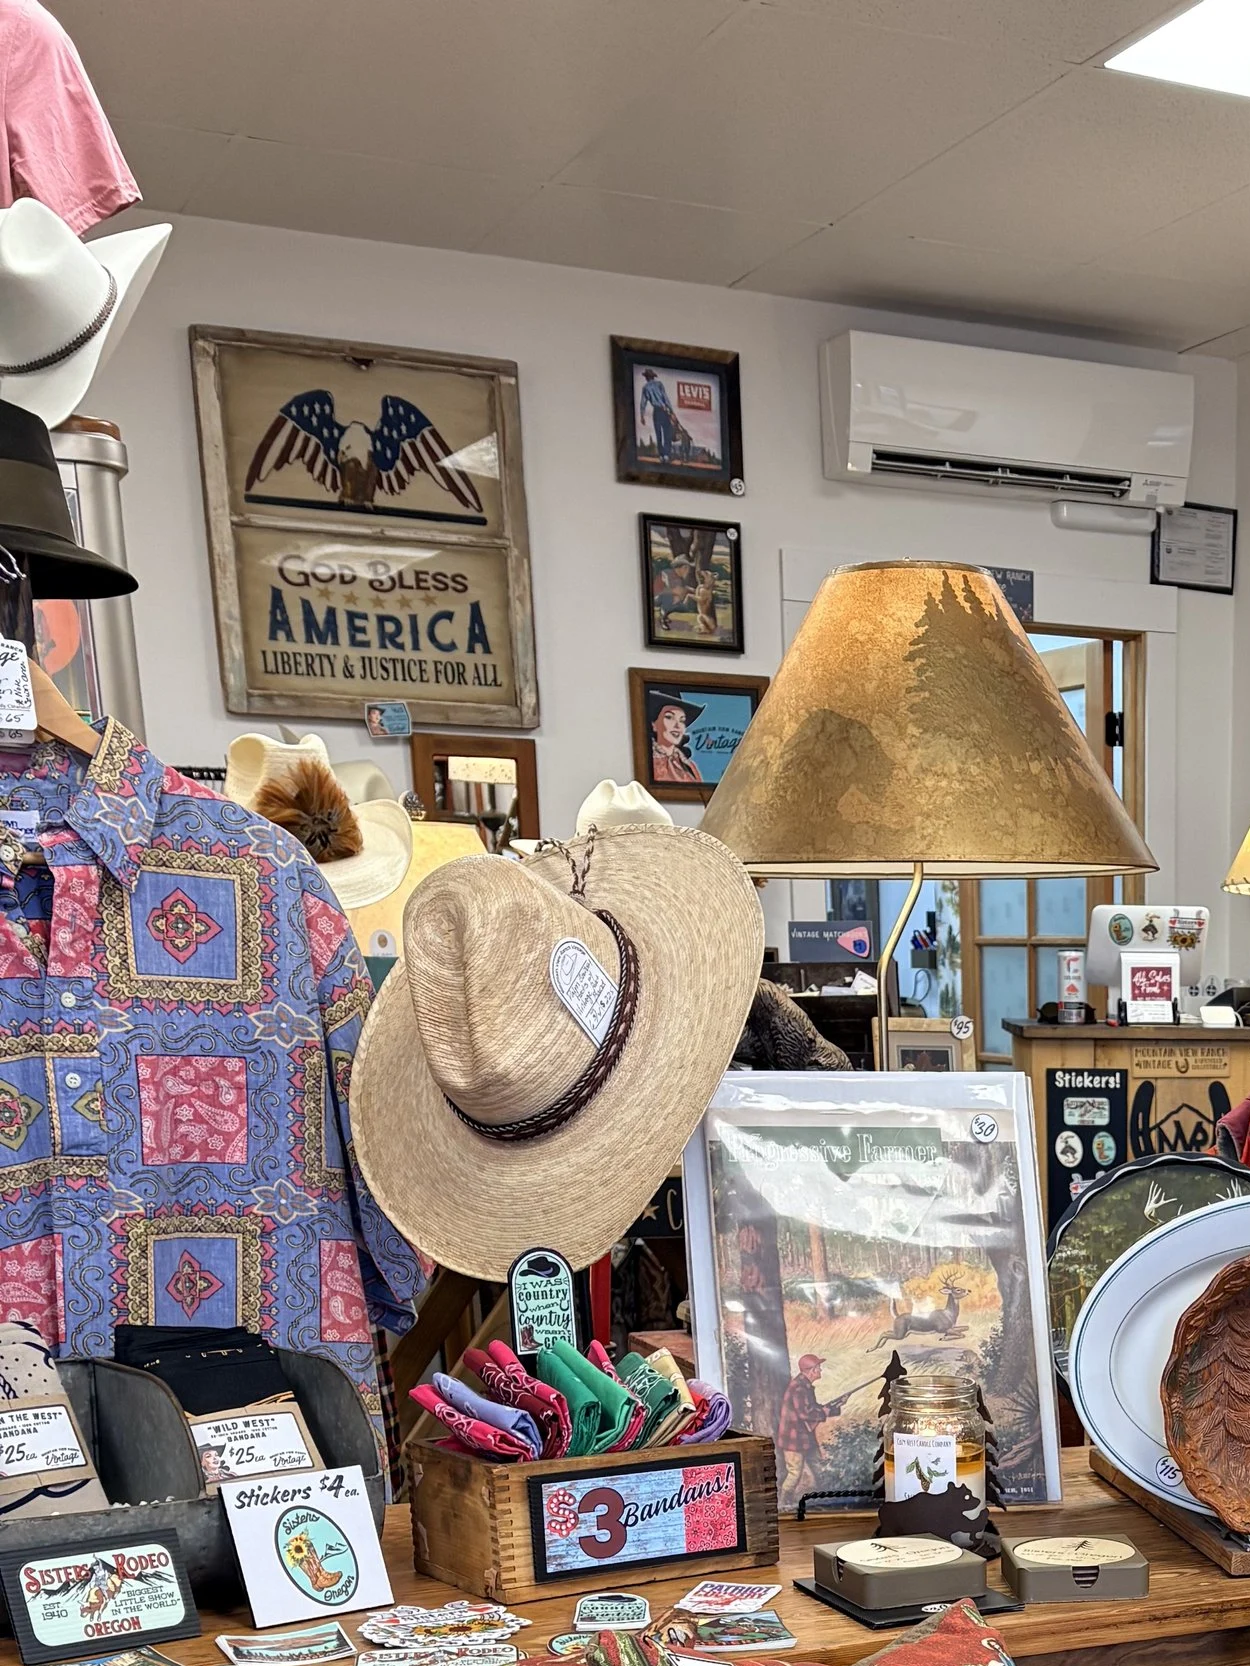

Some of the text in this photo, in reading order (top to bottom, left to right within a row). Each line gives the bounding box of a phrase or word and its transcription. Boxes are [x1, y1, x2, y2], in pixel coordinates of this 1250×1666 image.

[277, 553, 469, 593] GOD BLESS
[268, 585, 493, 655] AMERICA
[261, 650, 502, 688] LIBERTY & JUSTICE FOR ALL
[695, 734, 743, 754] Vintag
[791, 928, 820, 939] VINTAGE
[954, 1020, 973, 1034] $95
[1054, 1072, 1121, 1089] Stickers!
[974, 1117, 996, 1137] $30
[857, 1133, 937, 1164] Farmer
[529, 1278, 563, 1288] WAS
[518, 1288, 568, 1301] country
[8, 1413, 29, 1422] THE
[227, 1432, 267, 1442] BANDANA
[229, 1446, 255, 1465] $25
[1161, 1458, 1180, 1479] $115
[235, 1474, 360, 1510] Stickers $4 ea.
[622, 1465, 732, 1528] Bandans!
[282, 1512, 320, 1535] Sisters
[23, 1551, 170, 1593] SISTERS RODEO
[323, 1575, 355, 1601] Oregon
[700, 1583, 776, 1594] PATRIOT
[114, 1592, 175, 1607] LITTLE SHOW
[42, 1609, 68, 1620] 1940
[111, 1608, 121, 1616] IN
[125, 1605, 143, 1613] THE
[83, 1616, 142, 1637] OREGON
[457, 1647, 514, 1658] RODEO
